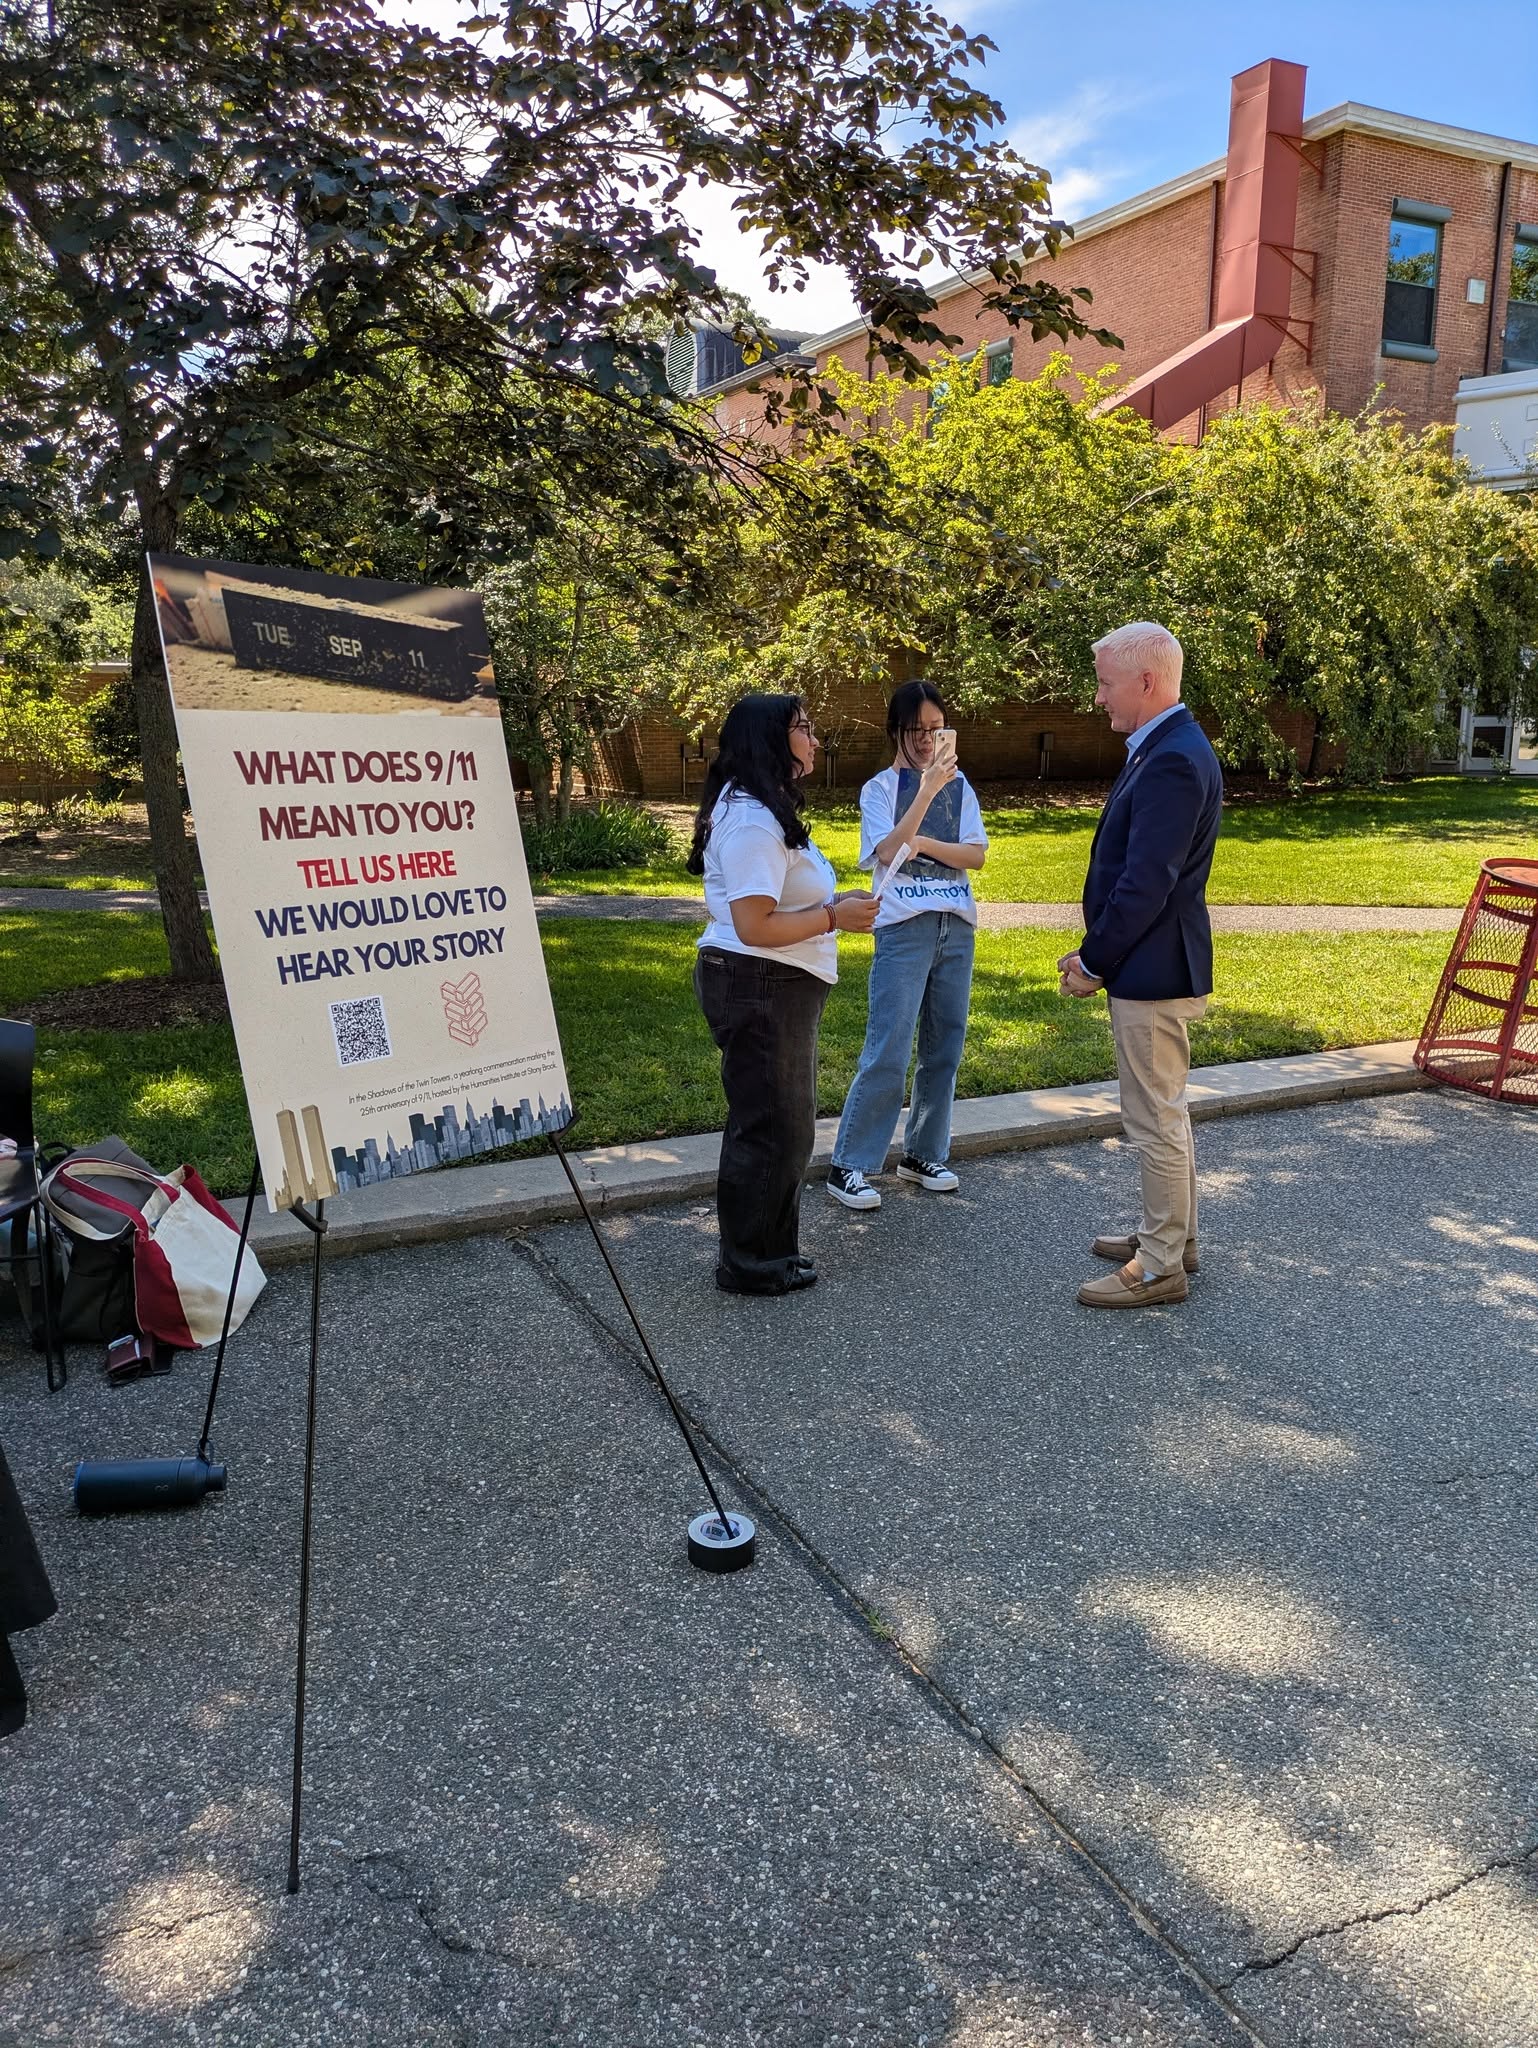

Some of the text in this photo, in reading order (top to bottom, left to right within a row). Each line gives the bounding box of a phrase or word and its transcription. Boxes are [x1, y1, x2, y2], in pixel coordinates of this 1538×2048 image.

[252, 621, 425, 669] TUE SEP 11
[233, 750, 336, 785] WHAT
[342, 750, 422, 783] DOES
[259, 800, 475, 841] MEAN TO YOU?
[297, 850, 457, 889] TELL US HERE
[254, 885, 507, 938] WE WOULD LOVE TO
[277, 926, 505, 985] HEAR YOUR STORY
[348, 1095, 355, 1105] In
[355, 1093, 367, 1103] the
[367, 1087, 397, 1101] Shadows
[397, 1083, 405, 1093] of
[405, 1082, 415, 1091] the
[415, 1079, 430, 1088] Twin
[458, 1066, 483, 1081] yearlong
[483, 1055, 527, 1073] commemoration
[526, 1050, 547, 1062] marking
[547, 1048, 556, 1057] the
[360, 1104, 376, 1117] 25th
[376, 1098, 411, 1113] anniversary
[411, 1094, 418, 1104] of
[431, 1086, 452, 1098] hosted
[452, 1085, 460, 1095] by
[460, 1082, 470, 1092] the
[470, 1076, 500, 1090] Humanities
[500, 1071, 521, 1082] Institute
[527, 1066, 542, 1076] Stony
